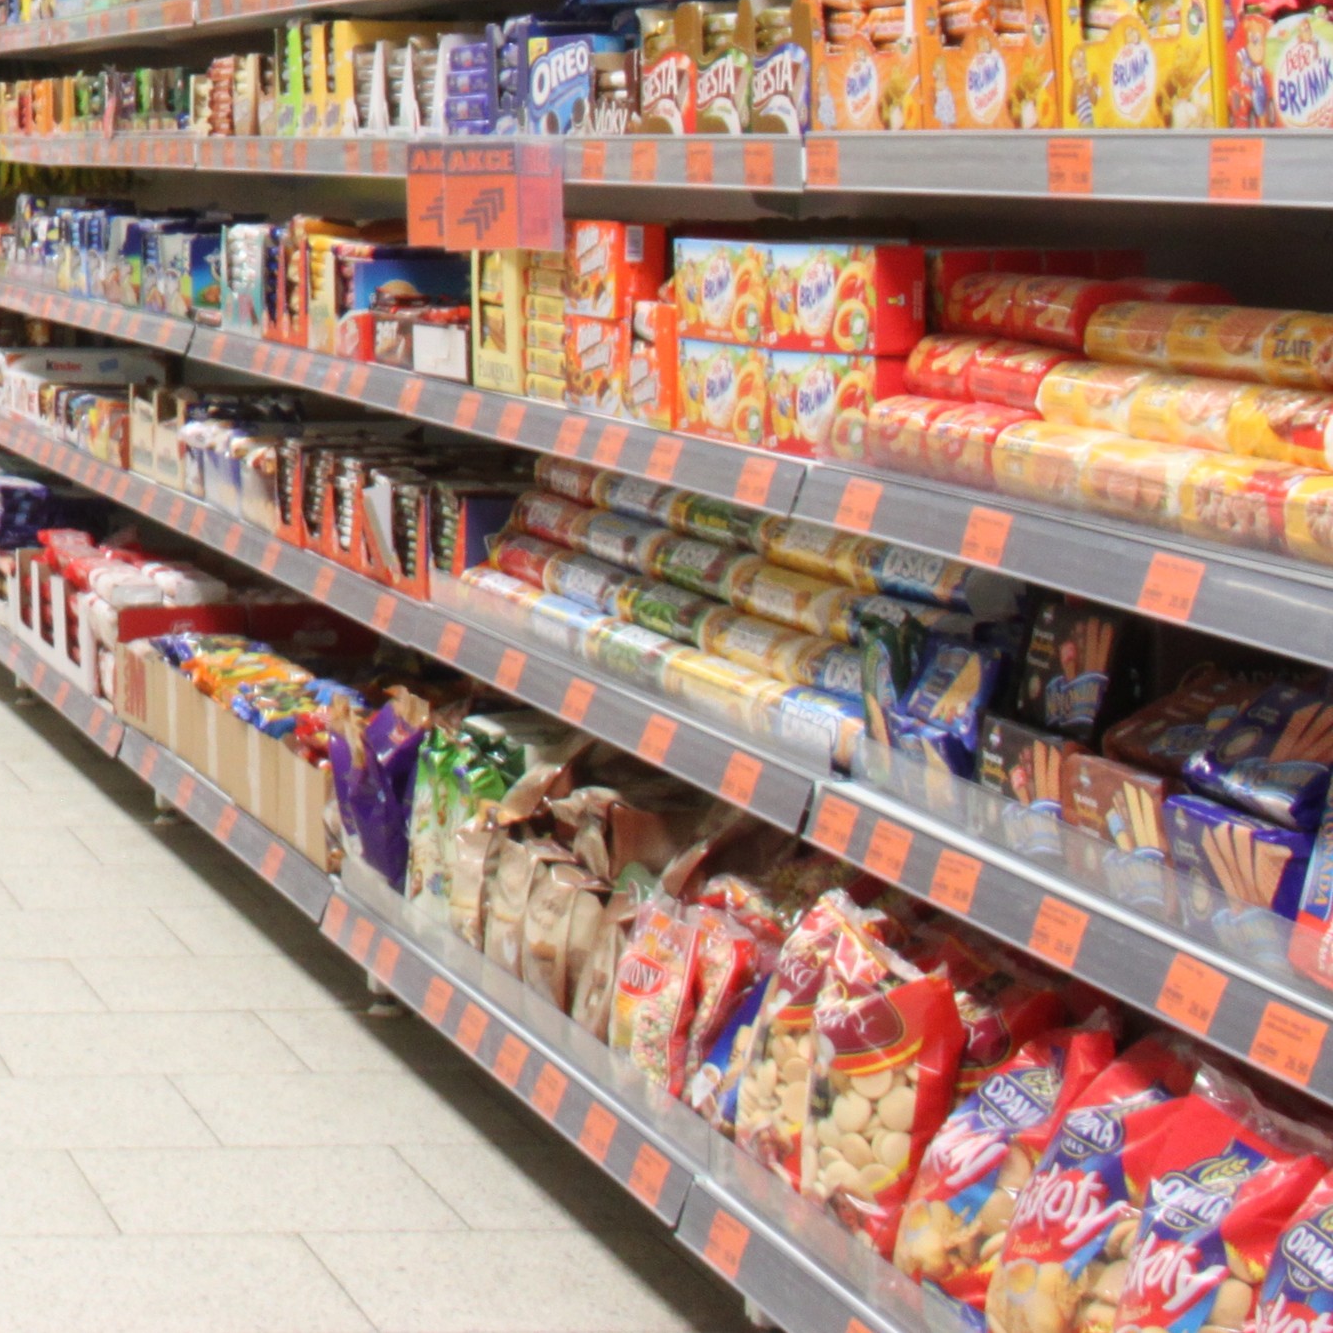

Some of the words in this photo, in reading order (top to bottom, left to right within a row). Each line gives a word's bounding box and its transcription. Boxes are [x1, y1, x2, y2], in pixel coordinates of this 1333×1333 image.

[532, 45, 589, 108] OREO
[696, 56, 735, 104] SIESTA
[752, 53, 793, 102] SIESTA
[411, 149, 445, 172] AK
[447, 148, 515, 173] AKCE
